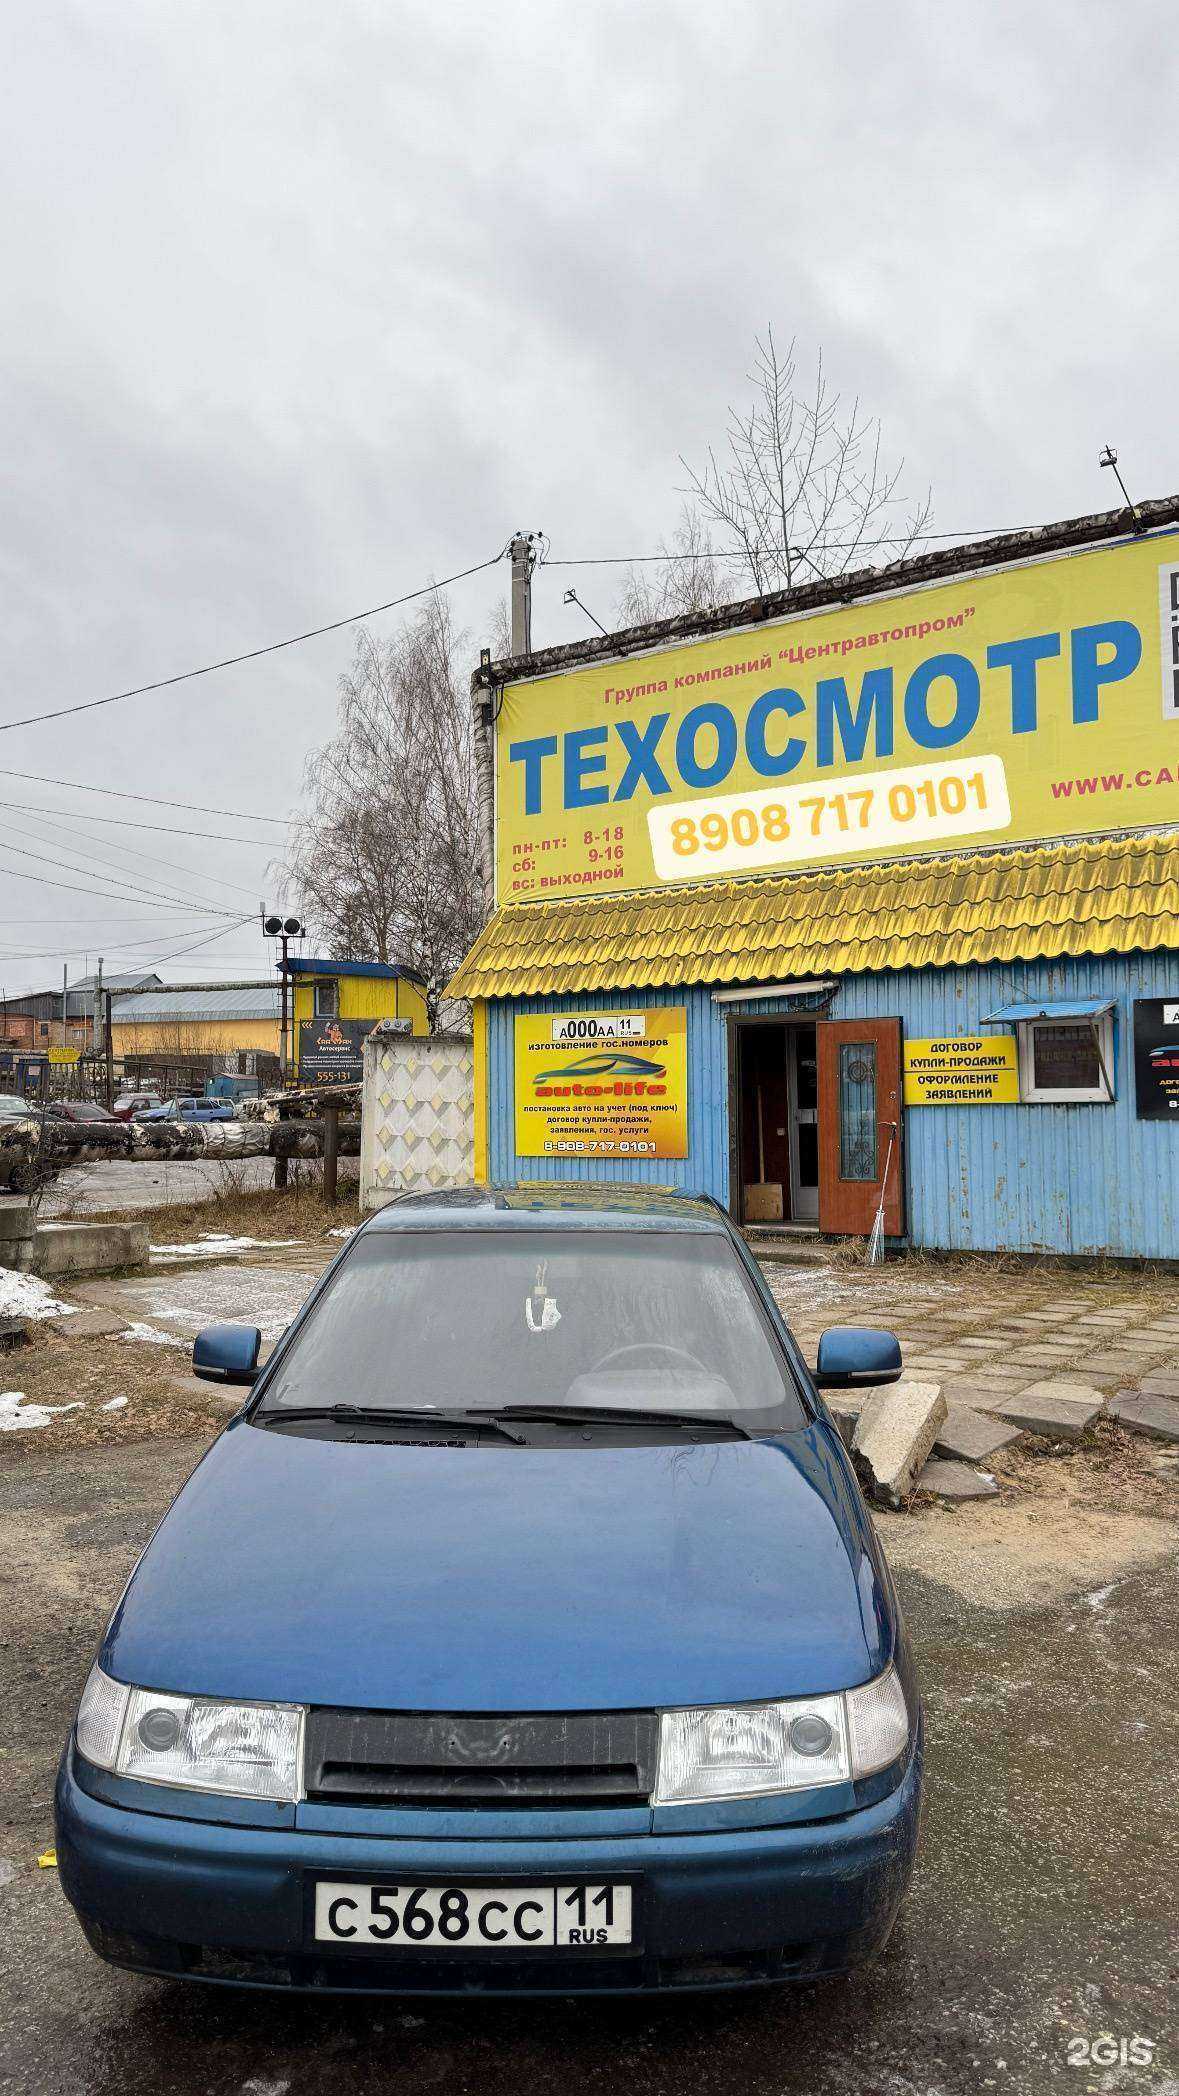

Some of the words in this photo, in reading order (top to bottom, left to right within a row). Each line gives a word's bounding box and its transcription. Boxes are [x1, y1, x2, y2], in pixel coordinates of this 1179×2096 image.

[604, 678, 668, 705] Группа
[674, 654, 772, 689] компаний
[509, 620, 1143, 816] ТЕХОСМОТР
[671, 804, 791, 857] 8908
[799, 790, 875, 836] 717
[888, 772, 988, 822] 0101
[512, 838, 567, 855] пн-пт:
[583, 826, 624, 845] 8-18
[512, 857, 536, 873] сб:
[588, 845, 624, 862] 9-16
[512, 879, 535, 891] вс:
[540, 864, 624, 887] выходной
[528, 1041, 598, 1051] изготовление
[601, 1039, 669, 1049] гос.номеров
[930, 1042, 983, 1053] ДОГОВОР
[910, 1056, 1006, 1068] КУПЛИ-ПРОДАЖИ
[317, 1071, 350, 1082] 555-131
[917, 1074, 999, 1085] ОФОРМЛЕНИЕ
[535, 1081, 668, 1097] auto-life
[925, 1088, 993, 1099] ЗАЯВЛЕНИЙ
[523, 1104, 571, 1112] постановка
[572, 1104, 592, 1112] авто
[594, 1104, 605, 1112] на
[607, 1104, 626, 1113] учет
[628, 1103, 648, 1113] (под
[650, 1103, 678, 1113] ключ)
[546, 1116, 580, 1124] договор
[582, 1114, 652, 1124] купли-продажи,
[550, 1126, 596, 1135] заявления,
[599, 1126, 616, 1134] гос.
[619, 1126, 649, 1135] услуги
[544, 1140, 656, 1152] 8-908-717-0101
[564, 1886, 613, 1926] 11
[568, 1928, 608, 1944] RUS
